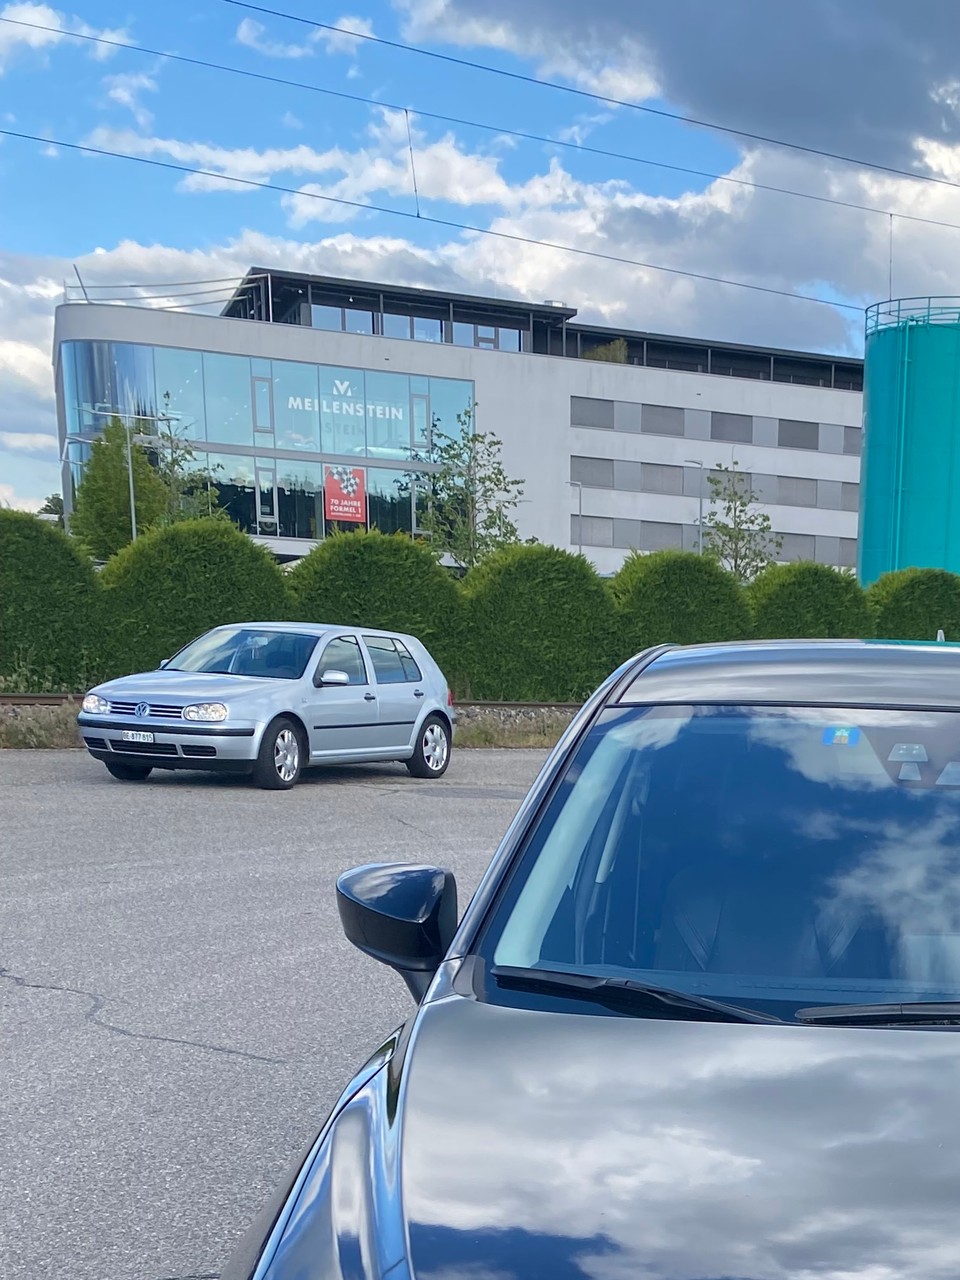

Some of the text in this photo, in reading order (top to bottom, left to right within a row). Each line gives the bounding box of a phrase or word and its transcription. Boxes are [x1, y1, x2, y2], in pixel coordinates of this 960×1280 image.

[288, 396, 403, 420] MEILENSTEIN
[330, 498, 361, 507] 70 JAHRE
[330, 505, 356, 513] FORMEL
